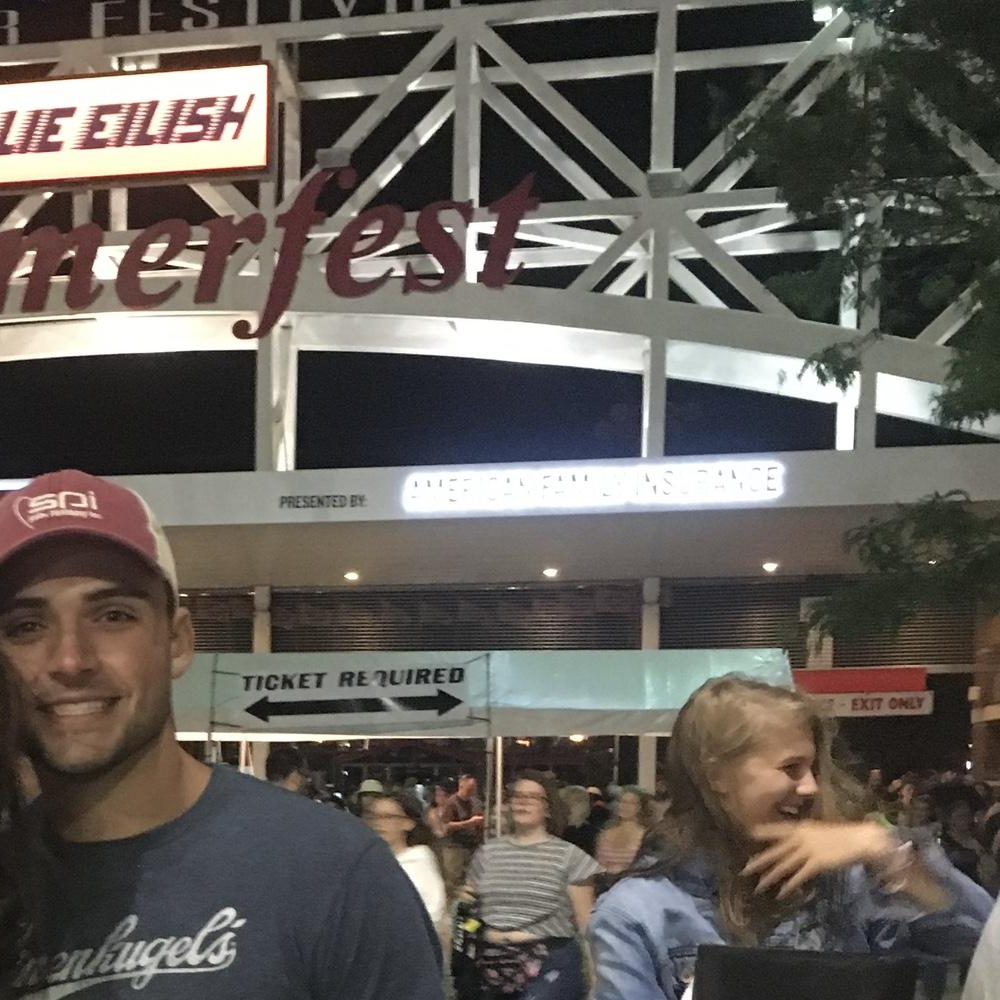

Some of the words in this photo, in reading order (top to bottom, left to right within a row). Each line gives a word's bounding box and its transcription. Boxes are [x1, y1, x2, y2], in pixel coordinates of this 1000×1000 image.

[91, 0, 465, 38] FESTI
[70, 94, 255, 150] EILISH
[409, 476, 532, 504] AMERCAN
[635, 466, 779, 497] NSRANCE
[279, 495, 347, 508] PRESENTED
[242, 672, 327, 691] TICKET
[338, 667, 465, 688] REQUIRED
[851, 698, 884, 711] EXIT
[888, 696, 926, 710] ONLY
